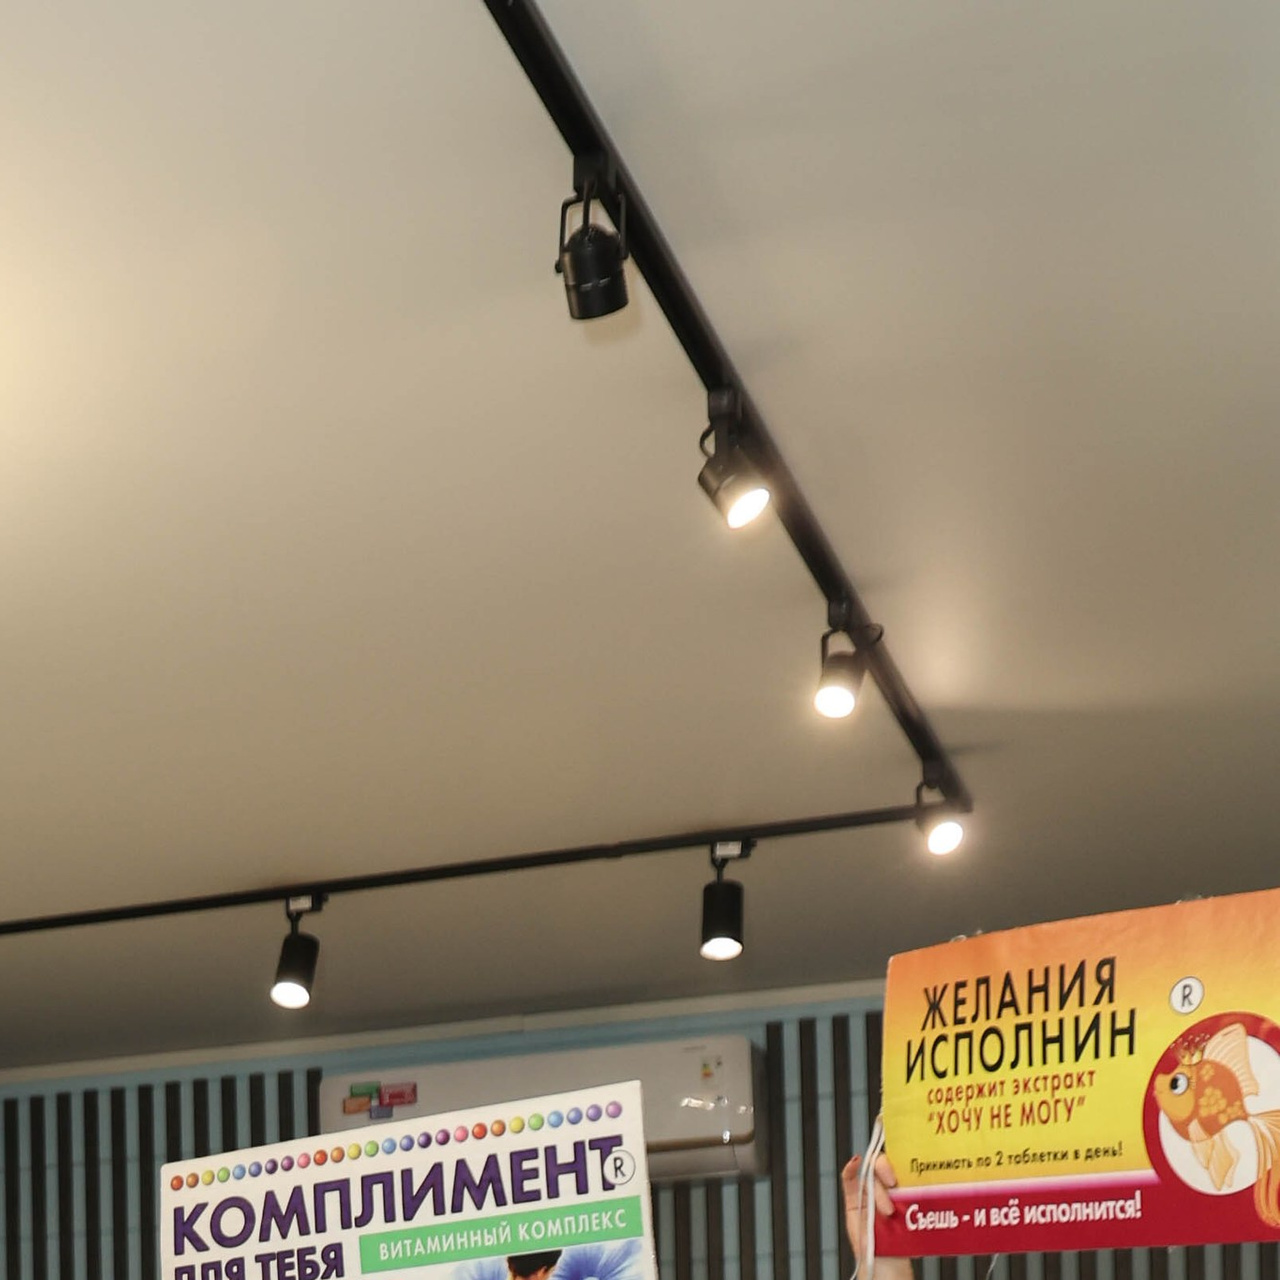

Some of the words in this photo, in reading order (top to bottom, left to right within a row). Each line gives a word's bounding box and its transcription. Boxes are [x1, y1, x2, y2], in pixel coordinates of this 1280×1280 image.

[921, 956, 1117, 1031] ЖЕЛАНИЯ
[905, 1008, 1137, 1085] ИСПОЛНИН
[927, 1080, 1006, 1106] содержит
[1013, 1069, 1096, 1098] экстракт
[990, 1103, 1013, 1129] НЕ
[910, 1158, 973, 1177] Принимать
[977, 1156, 992, 1168] по
[995, 1150, 1004, 1166] 2
[1008, 1147, 1069, 1165] таблетки
[1073, 1148, 1081, 1160] в
[1084, 1141, 1123, 1162] день!
[172, 1134, 623, 1256] КОМПЛИМЕНТ
[905, 1203, 959, 1231] Съешь
[974, 1208, 986, 1228] и
[990, 1198, 1020, 1227] всё
[1023, 1190, 1142, 1225] исполнится!
[378, 1219, 512, 1261] ВИТАМИННЫЙ
[518, 1208, 628, 1242] КОМПЛЕКС
